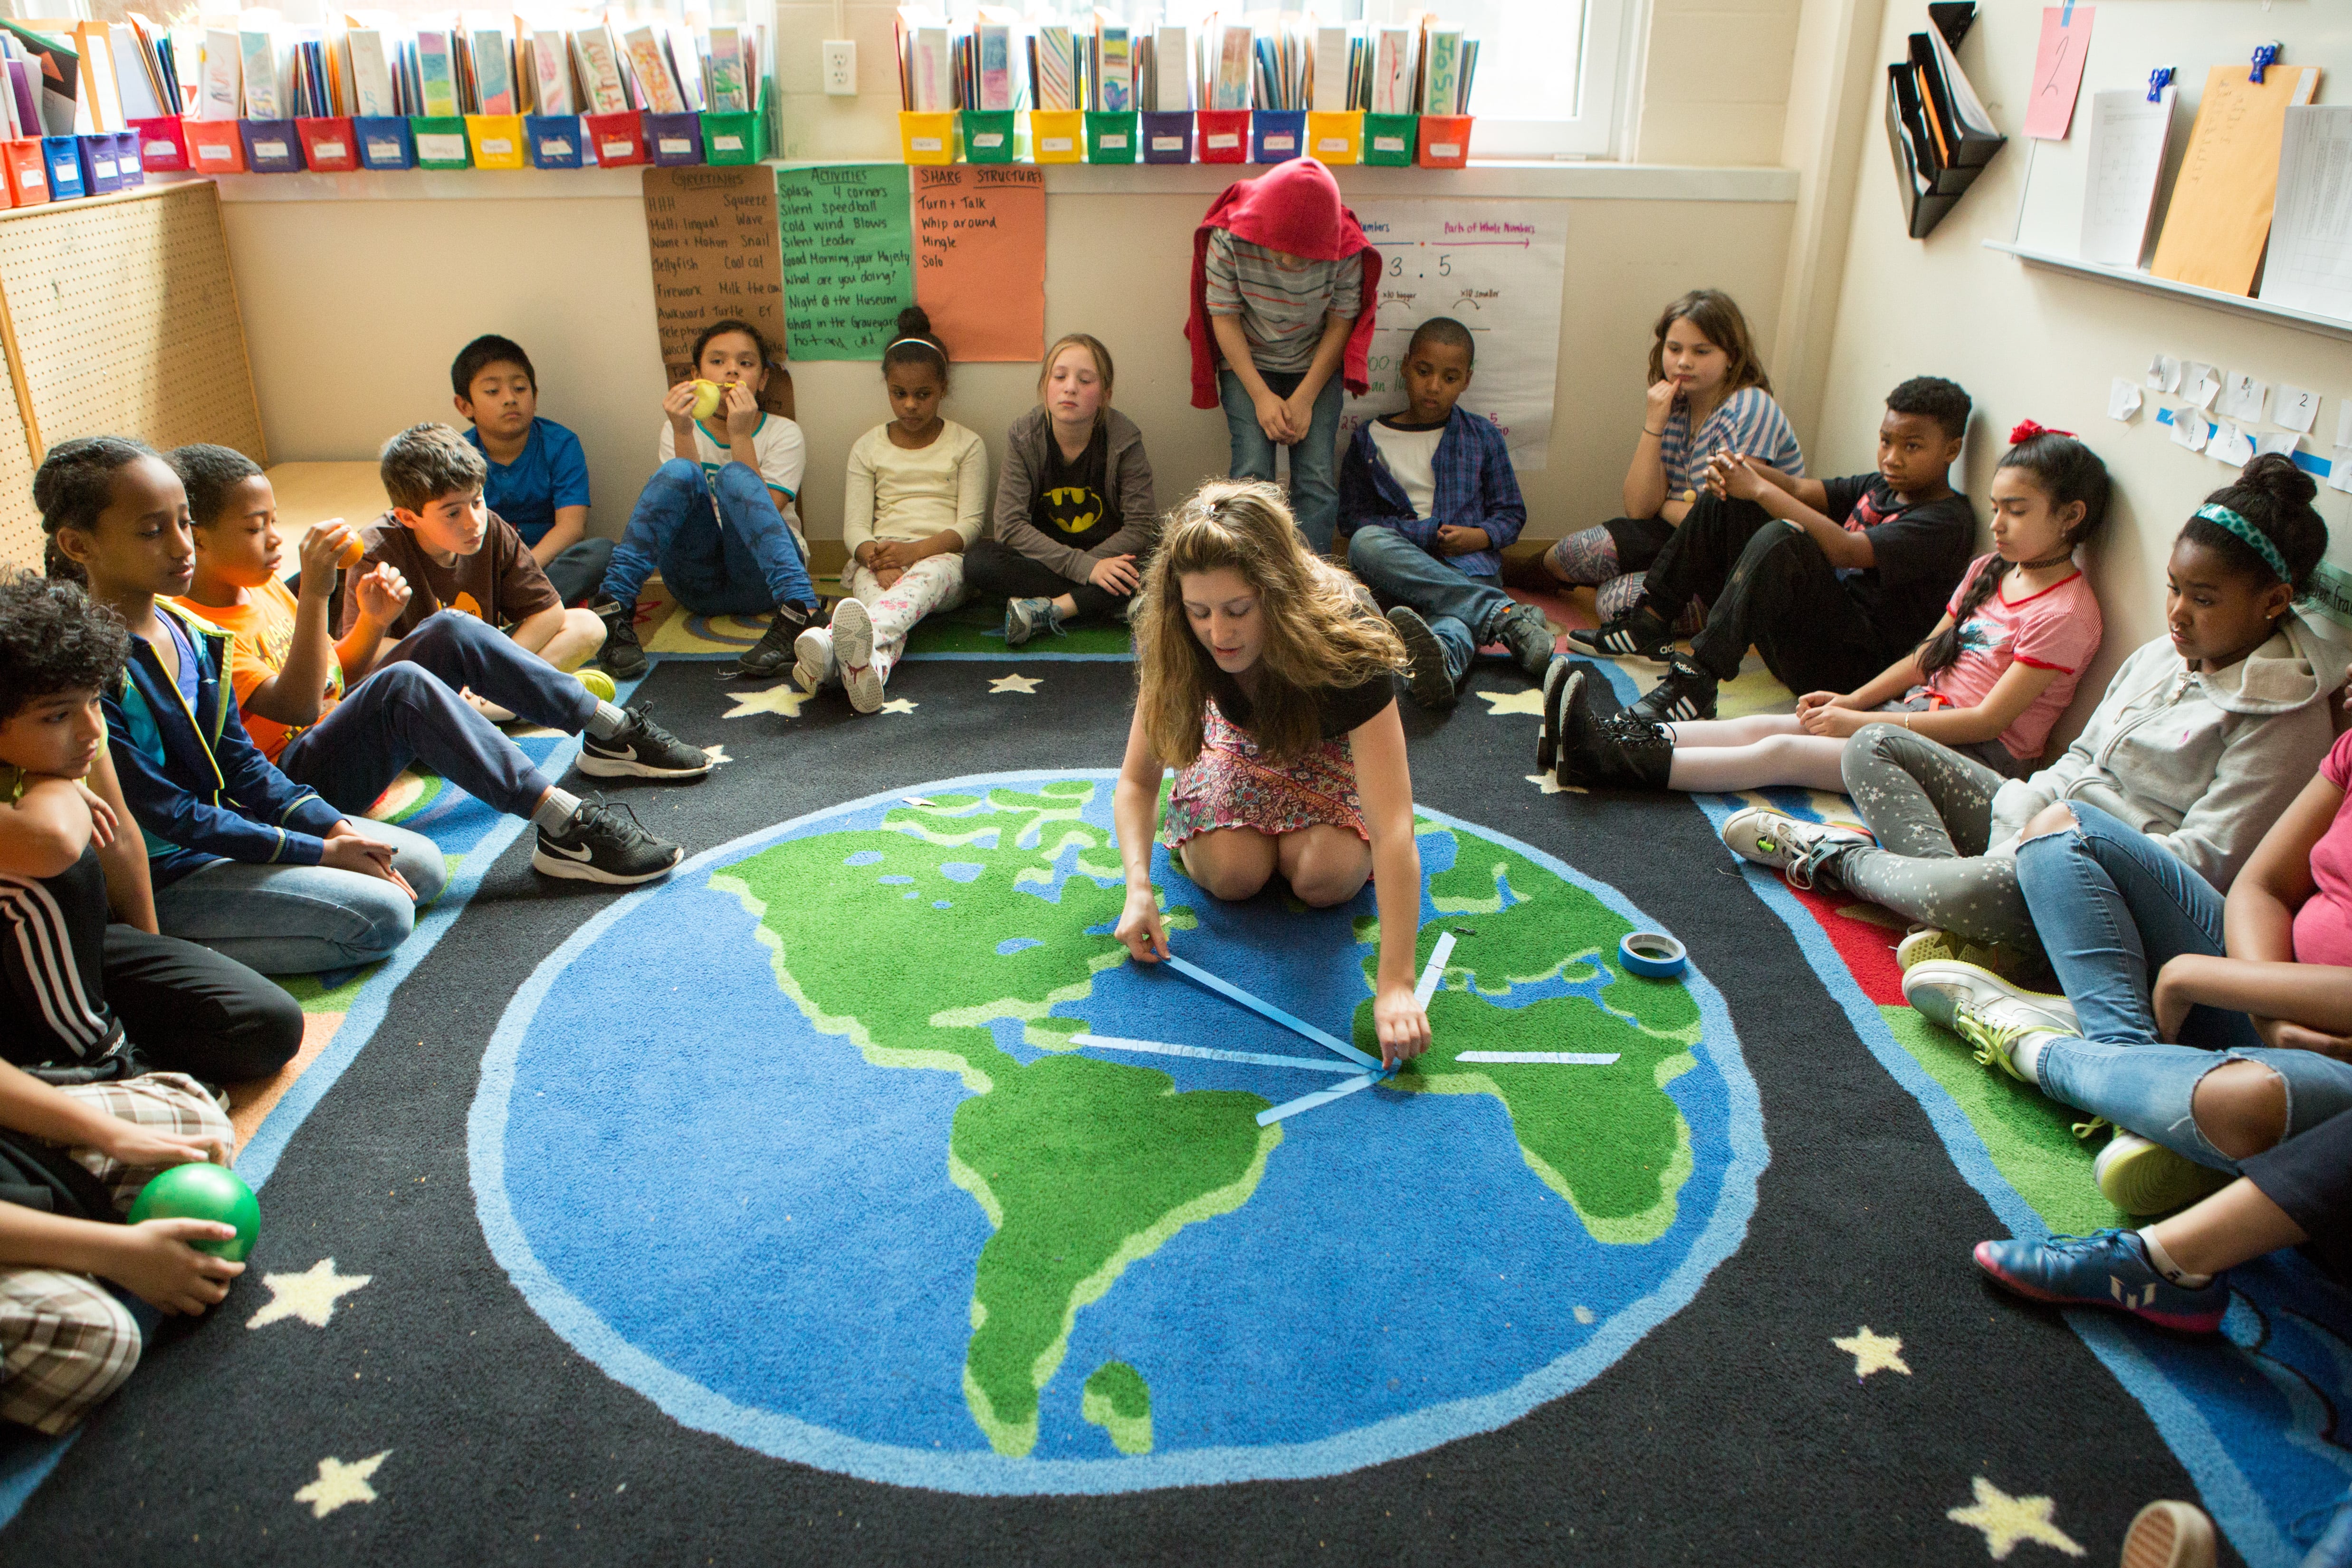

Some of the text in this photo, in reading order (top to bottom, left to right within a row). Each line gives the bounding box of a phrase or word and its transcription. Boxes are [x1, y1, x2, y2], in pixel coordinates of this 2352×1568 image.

[811, 168, 867, 182] ACTIVITIES
[921, 168, 1042, 183] SHARE STRUCTURES
[779, 183, 888, 201] Splash 4 corners
[723, 193, 767, 210] Squeeze
[781, 202, 813, 216] Silent
[918, 194, 947, 210] Turn
[960, 195, 986, 210] Talk
[853, 216, 887, 229] Blows
[921, 216, 997, 232] Whip around
[1467, 222, 1477, 234] of
[1479, 221, 1501, 234] Whole
[1503, 221, 1535, 235] Numbers
[739, 232, 770, 248] Snail
[783, 233, 855, 248] Silent Leader
[923, 234, 957, 252] Mingle
[724, 255, 745, 270] Cool
[747, 255, 765, 268] cat
[877, 249, 910, 267] Majesty
[922, 254, 943, 268] Solo
[1389, 257, 1402, 277] 3
[1439, 254, 1451, 277] 5
[718, 280, 742, 296] Milk
[747, 280, 765, 295] the
[785, 272, 810, 286] What
[817, 276, 832, 286] are
[838, 274, 856, 289] you
[789, 293, 897, 312] Night @ the Museum
[711, 305, 744, 317] Turtle
[817, 320, 826, 328] in
[830, 317, 845, 328] the
[2299, 393, 2308, 407] 2
[1675, 661, 1698, 675] adida
